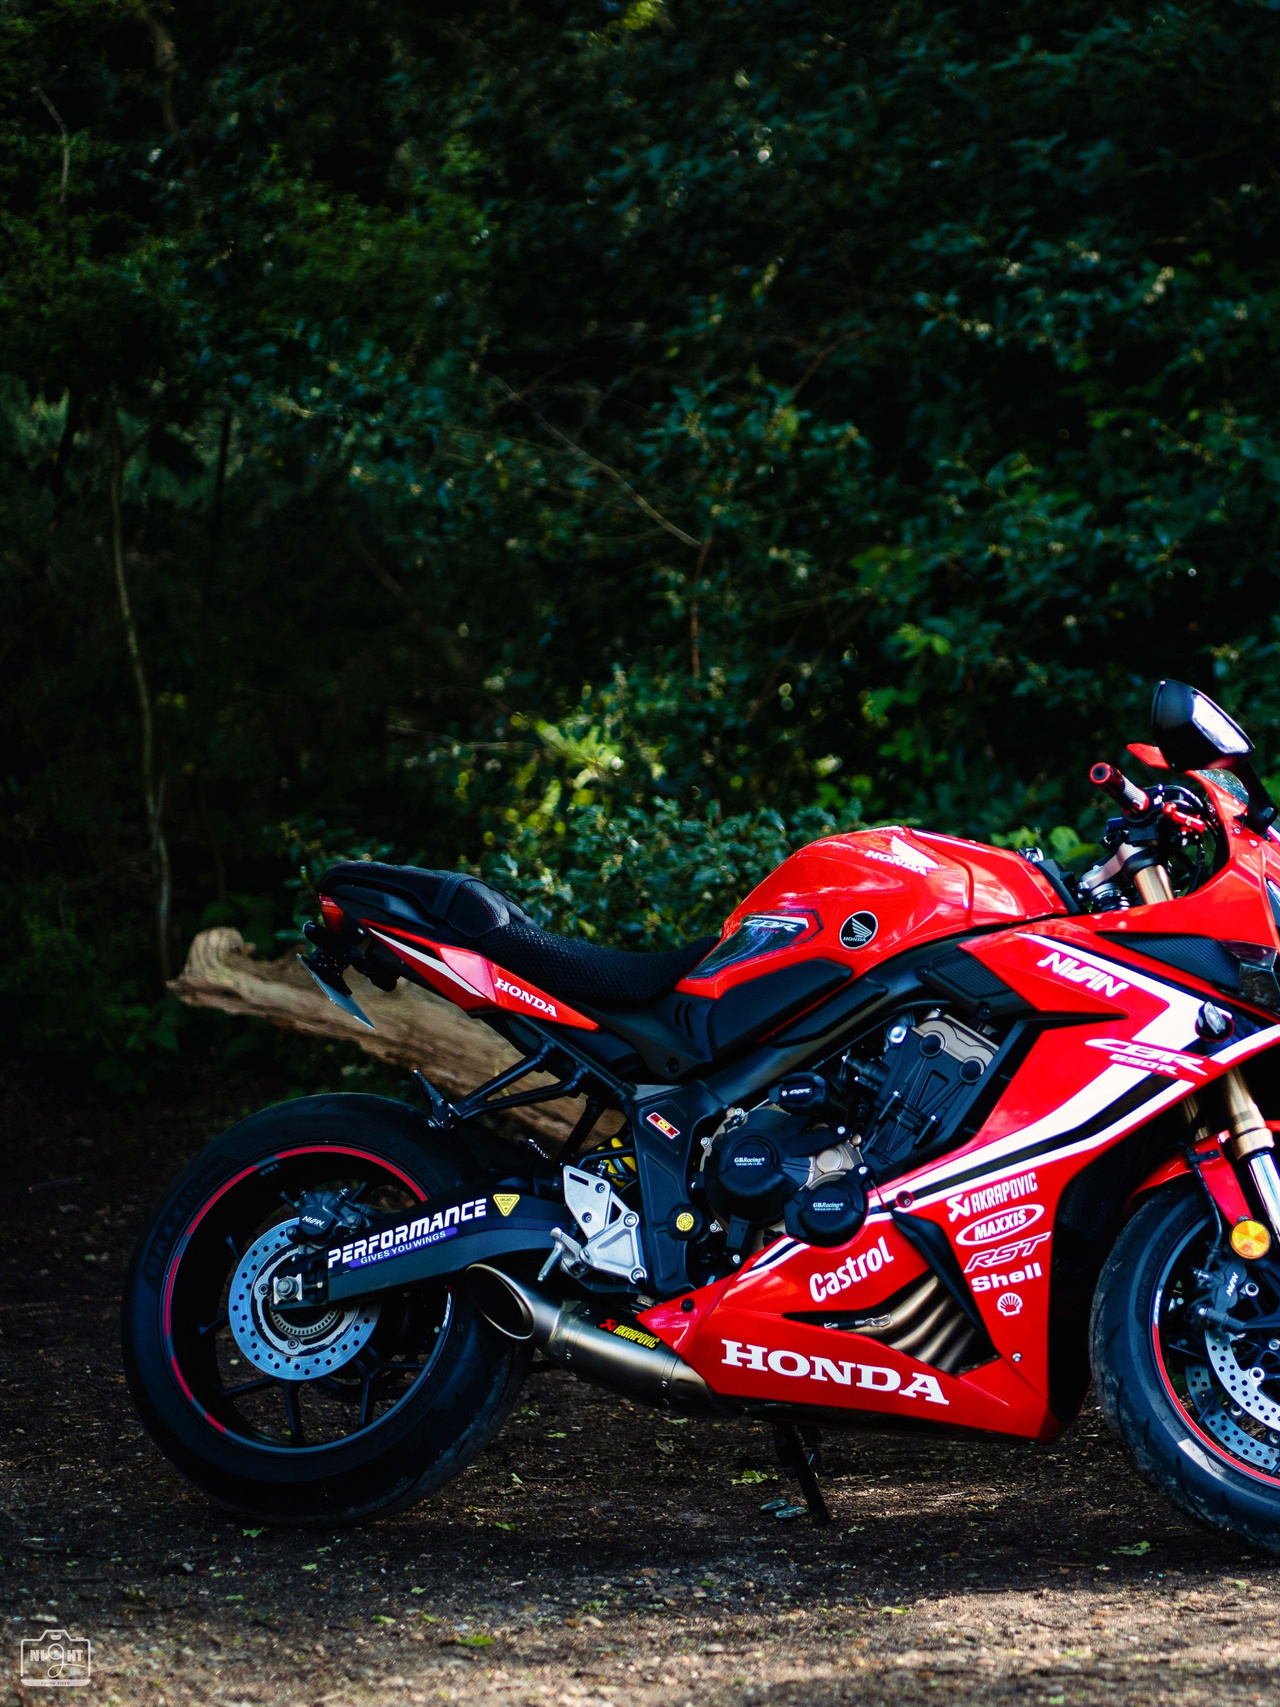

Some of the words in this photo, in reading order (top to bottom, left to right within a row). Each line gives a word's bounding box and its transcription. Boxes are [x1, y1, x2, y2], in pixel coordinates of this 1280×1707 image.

[864, 850, 928, 876] HONDA
[743, 919, 798, 932] CBR
[494, 977, 558, 1018] HONDA
[1085, 1038, 1208, 1076] CBR
[1109, 1053, 1179, 1076] 650R
[971, 1172, 1038, 1213] AKRAPOVIC
[327, 1198, 487, 1269] PERFORMANCE
[974, 1209, 1027, 1241] MAXXIS
[361, 1249, 390, 1264] GIVES
[391, 1243, 412, 1255] YOU
[412, 1231, 446, 1248] WINGS
[963, 1231, 1052, 1273] RST
[809, 1236, 894, 1302] Castrol
[971, 1262, 1042, 1292] Shell
[721, 1339, 949, 1405] HONDA
